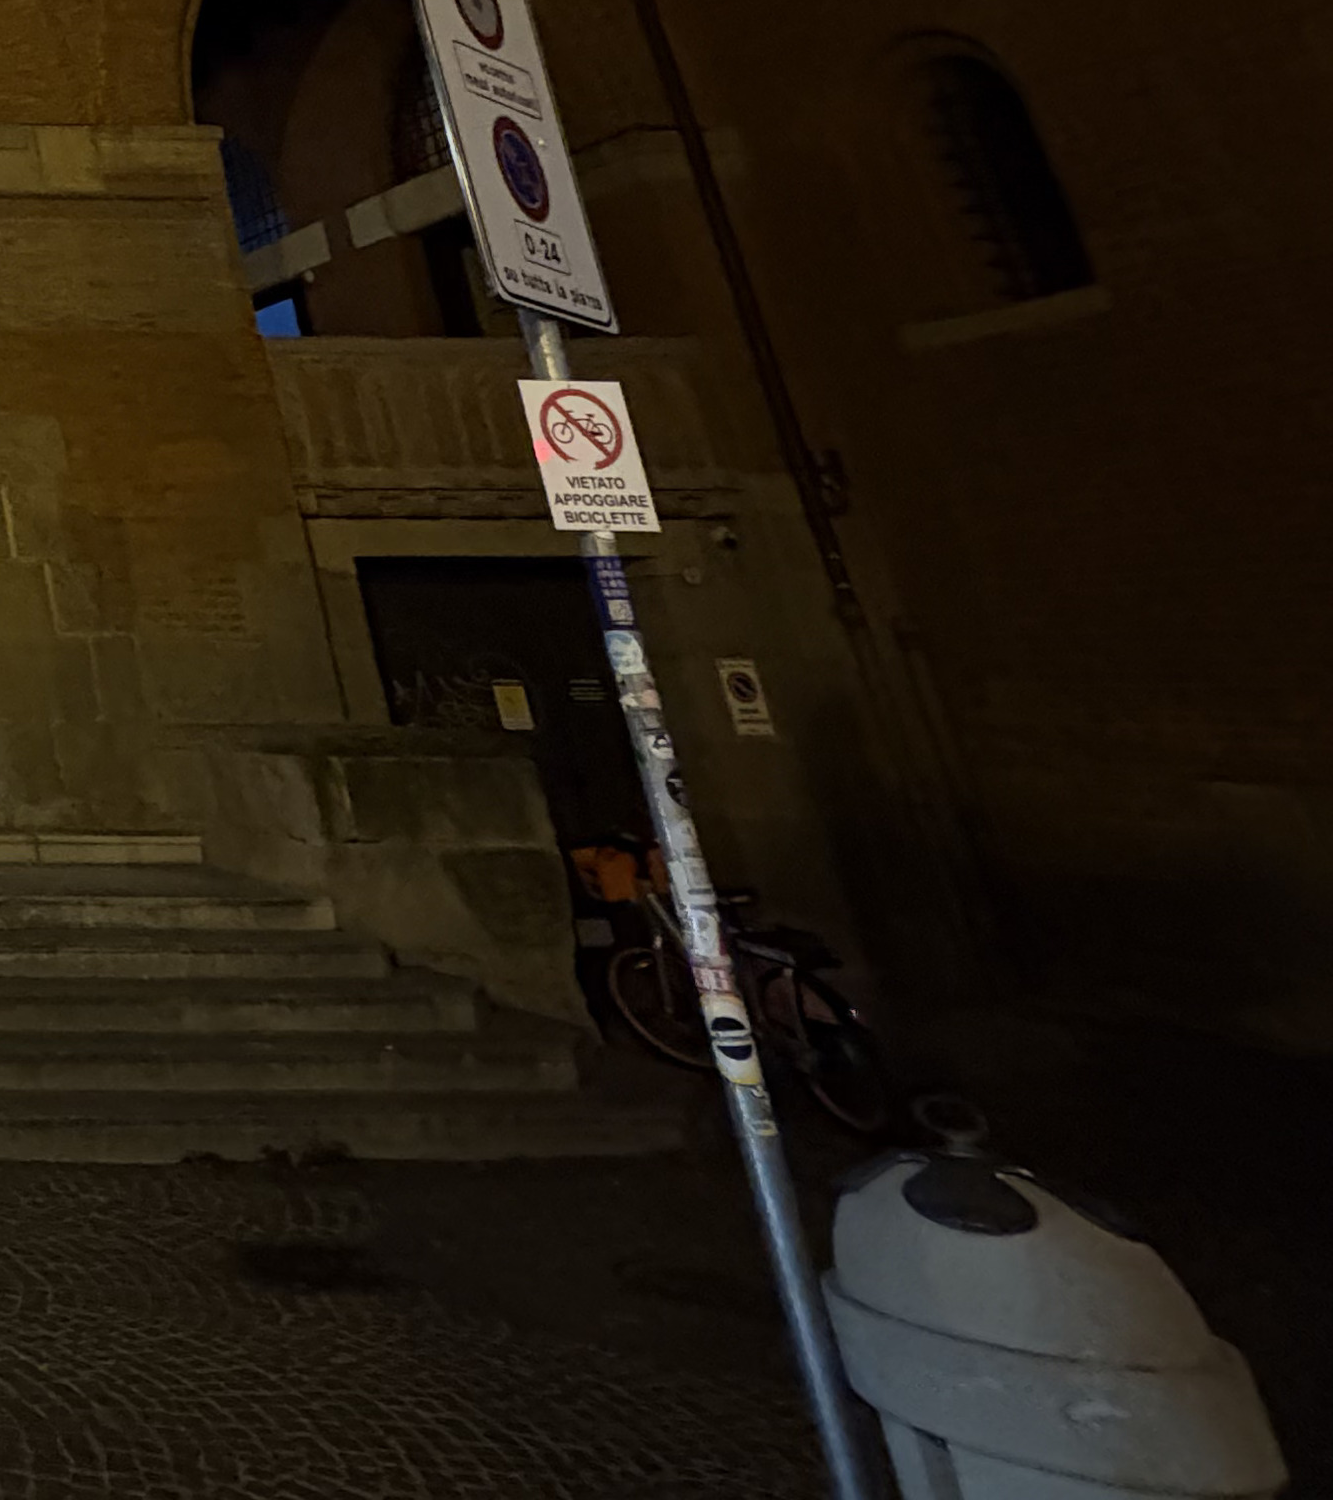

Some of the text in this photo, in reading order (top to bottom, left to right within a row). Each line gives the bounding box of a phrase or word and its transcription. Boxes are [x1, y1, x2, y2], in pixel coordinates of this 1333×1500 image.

[524, 232, 562, 264] 0-24
[565, 475, 626, 490] VIETATO
[554, 493, 650, 508] APPOGGIARE
[563, 511, 648, 526] BICICLETTE
